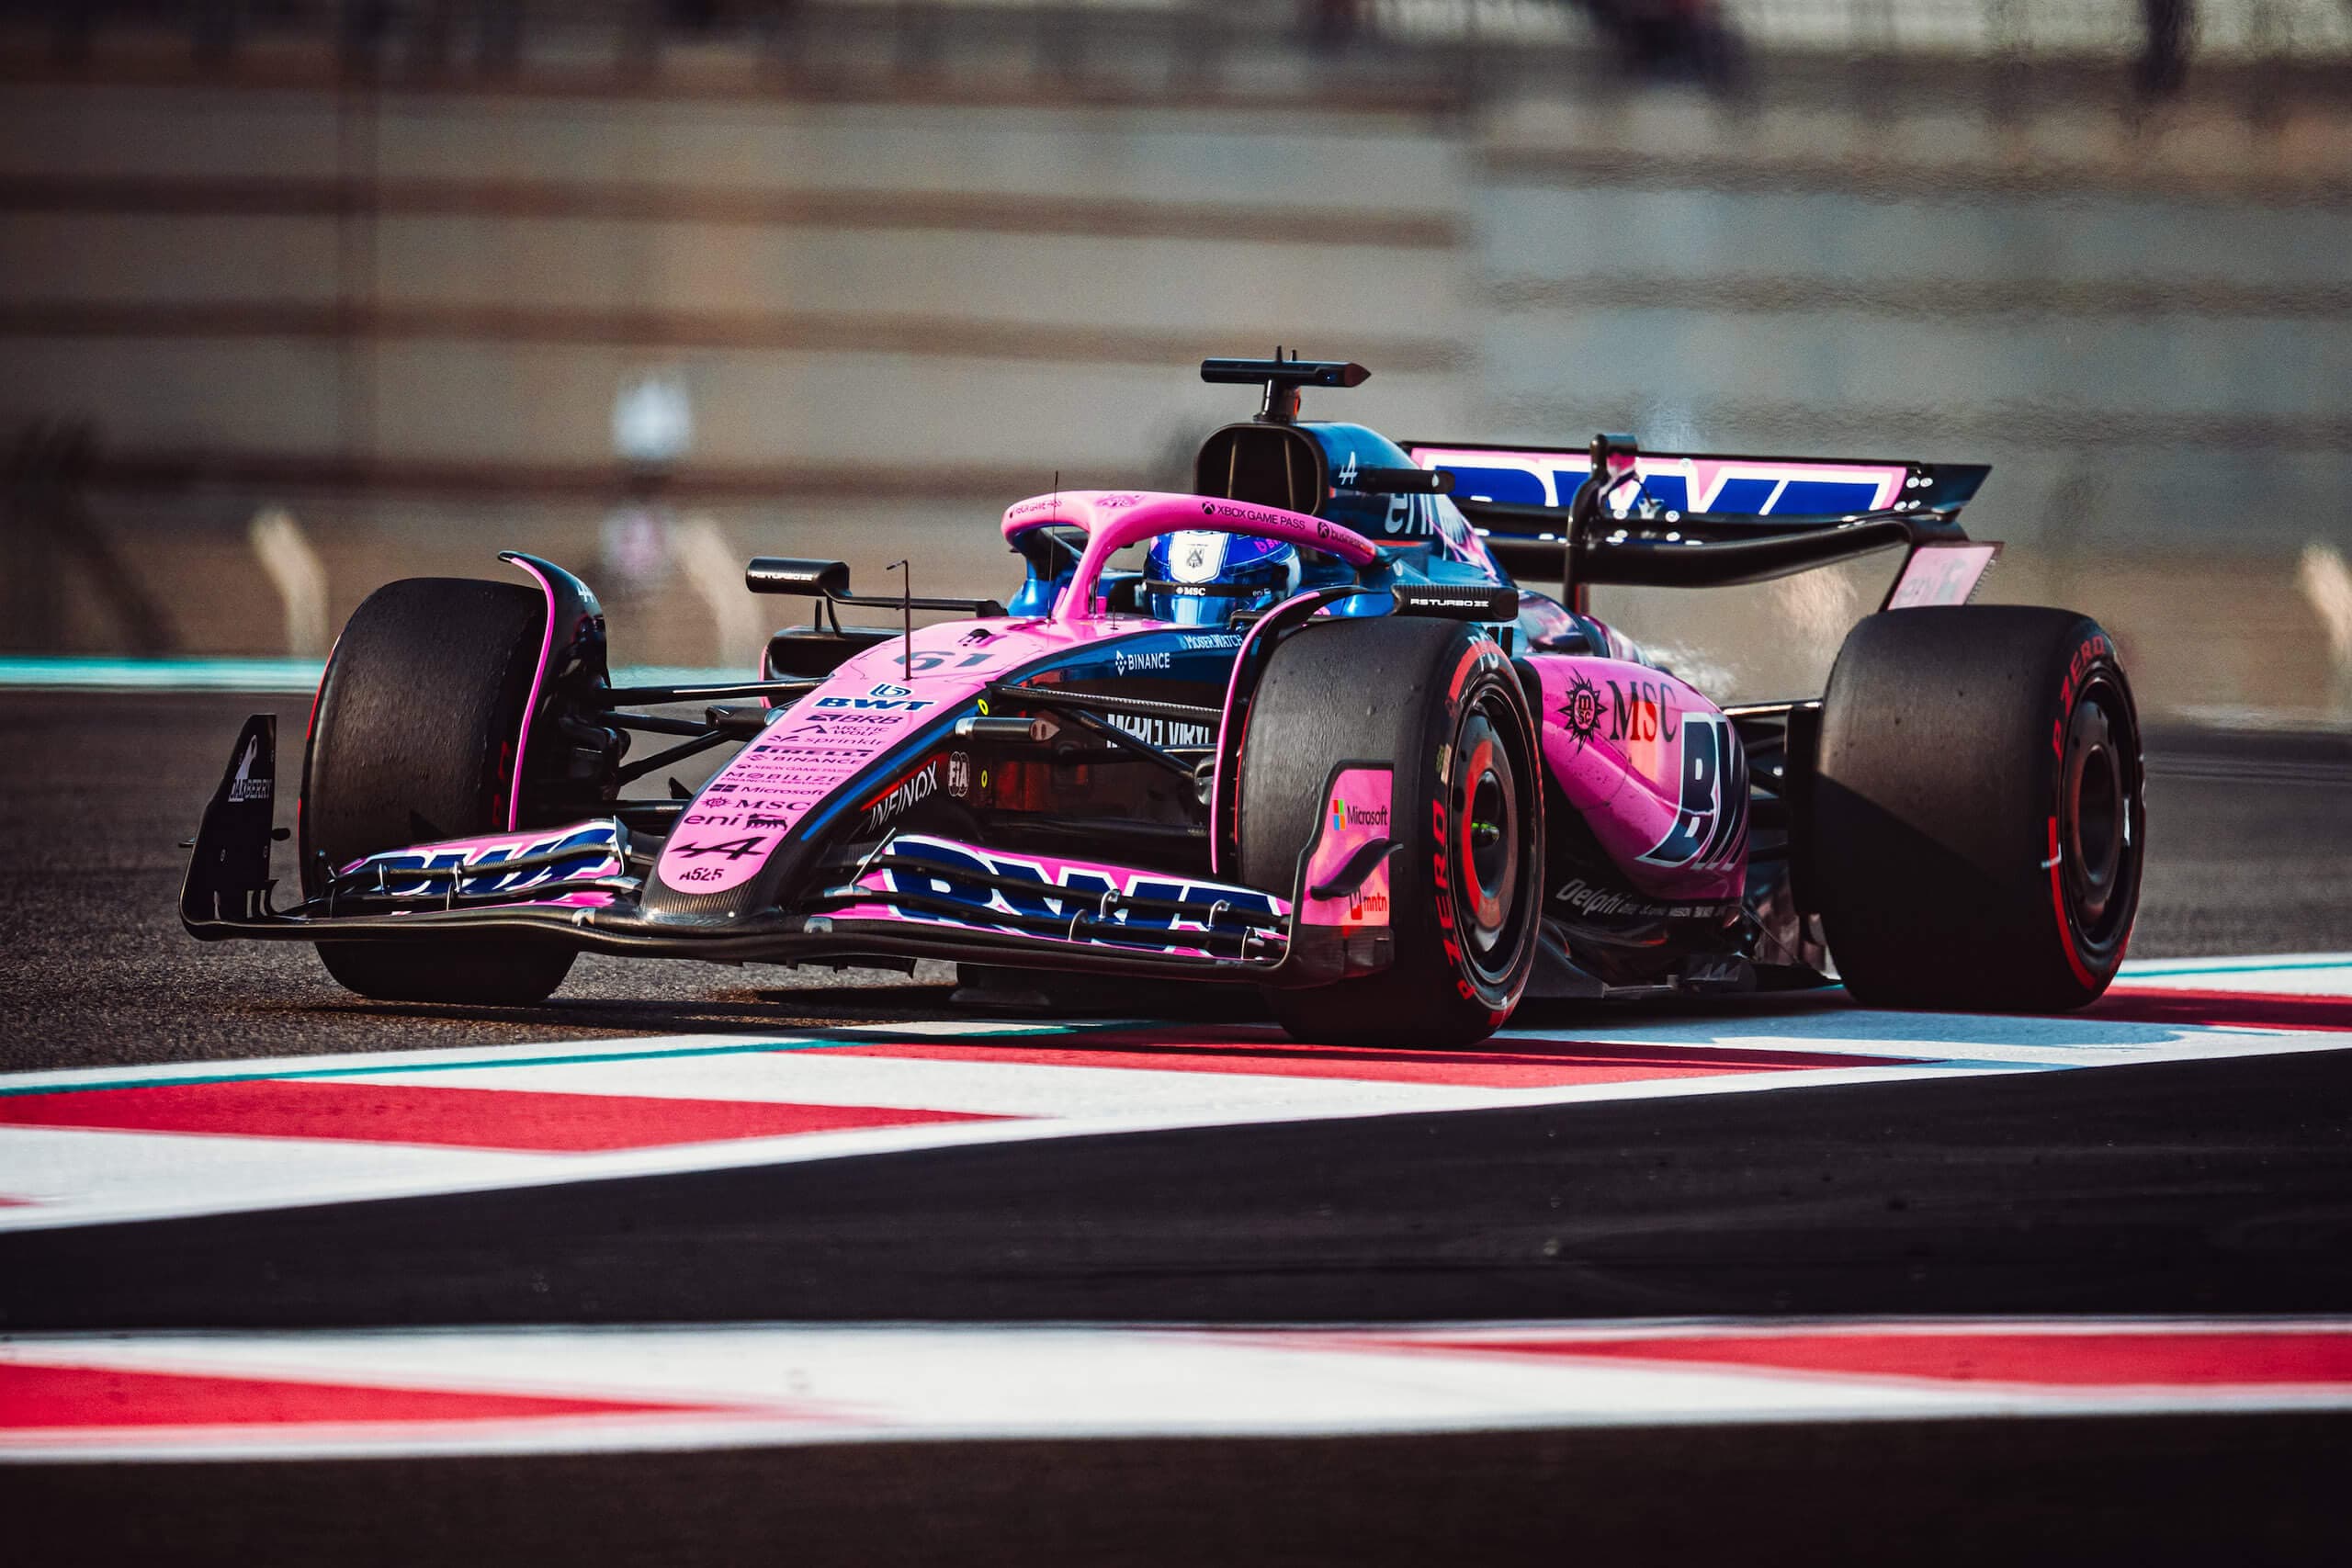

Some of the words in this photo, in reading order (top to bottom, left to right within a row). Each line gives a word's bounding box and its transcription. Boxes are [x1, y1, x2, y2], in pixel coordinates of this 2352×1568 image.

[1217, 504, 1247, 519] XBOX
[1248, 510, 1279, 525] GAME
[1280, 515, 1306, 530] PASS
[1183, 587, 1206, 596] MSC
[1127, 652, 1170, 671] BINANCE
[815, 696, 935, 712] BWT
[1606, 680, 1678, 742] MSC
[838, 715, 904, 725] BRB
[829, 725, 890, 733] ARCTIC
[773, 756, 864, 765] BINANCE
[741, 786, 826, 796] Microsoft
[867, 760, 938, 834] INFINOX
[734, 799, 812, 811] MSC
[683, 813, 743, 827] eni
[1347, 806, 1388, 827] Microsoft
[679, 867, 725, 881] A525
[1432, 799, 1463, 967] ZERO
[1363, 893, 1388, 912] mntn
[1555, 878, 1626, 917] Delphi
